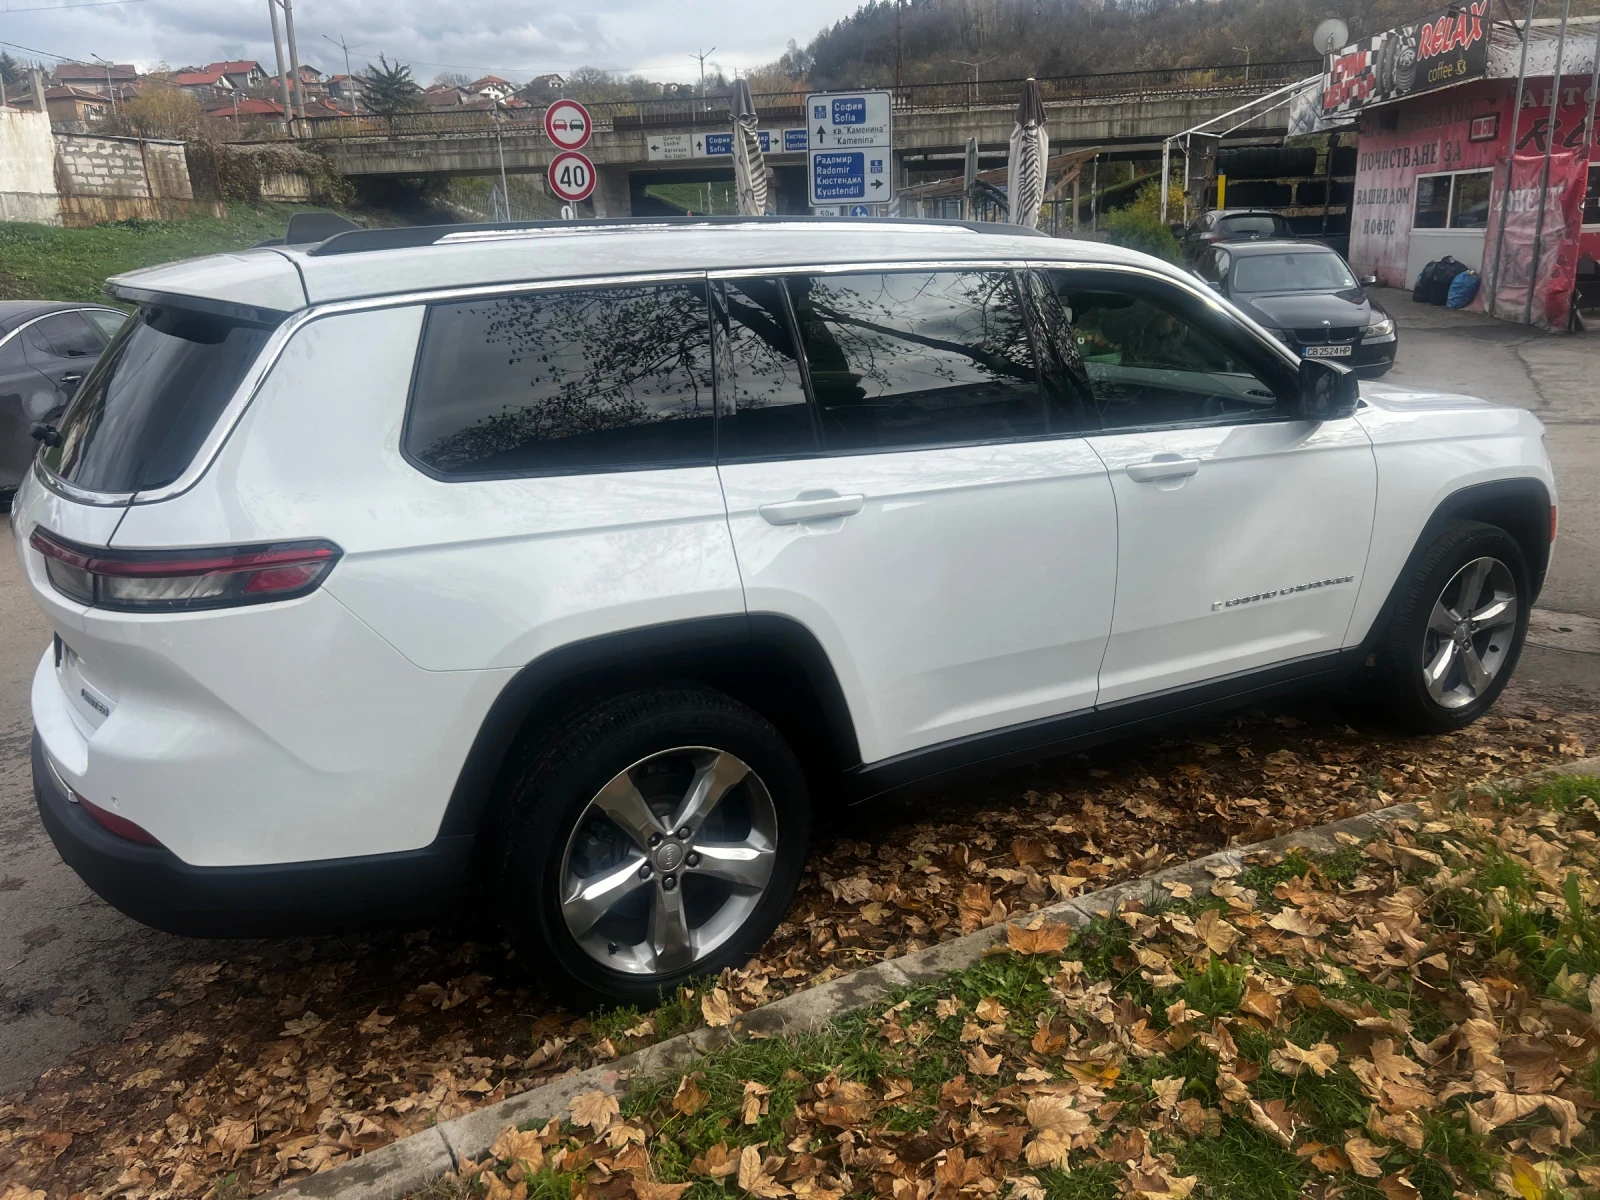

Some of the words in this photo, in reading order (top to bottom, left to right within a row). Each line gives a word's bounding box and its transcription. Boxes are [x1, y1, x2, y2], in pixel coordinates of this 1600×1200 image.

[1417, 0, 1488, 61] RELAX
[1334, 50, 1368, 83] ГУМИ
[1428, 60, 1453, 83] coffee
[1324, 74, 1375, 110] ЦЕНТЪР
[834, 102, 863, 112] София
[835, 113, 856, 122] Sofia
[816, 155, 852, 165] Радомир
[1360, 142, 1439, 172] ПОЧИСТВАНЕ
[1444, 140, 1462, 163] ЗА
[560, 165, 585, 188] 40
[816, 166, 850, 175] Radomir
[816, 176, 862, 185] Кюстендил
[817, 186, 859, 197] Kyustendil
[1356, 188, 1388, 205] ВАШИЯ
[1388, 187, 1411, 206] ДОМ
[1307, 347, 1318, 356] CB
[1319, 347, 1339, 356] 2524
[1340, 346, 1350, 354] HP
